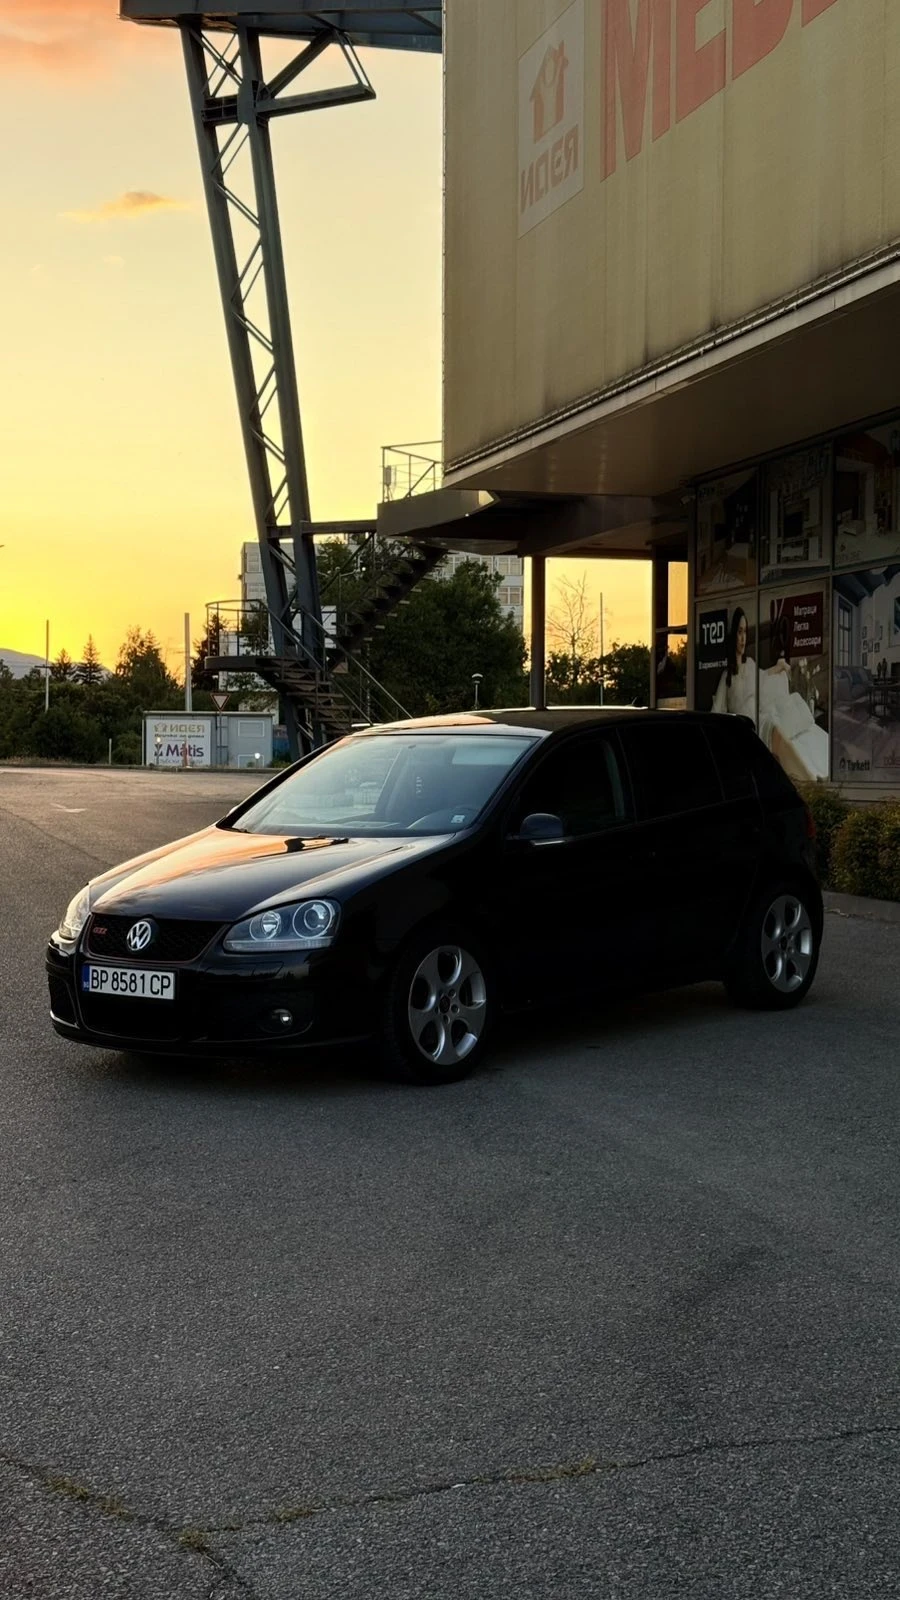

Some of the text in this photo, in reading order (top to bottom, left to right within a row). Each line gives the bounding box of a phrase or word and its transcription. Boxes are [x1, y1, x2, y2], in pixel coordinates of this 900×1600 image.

[91, 969, 171, 996] BP 8581 CP
